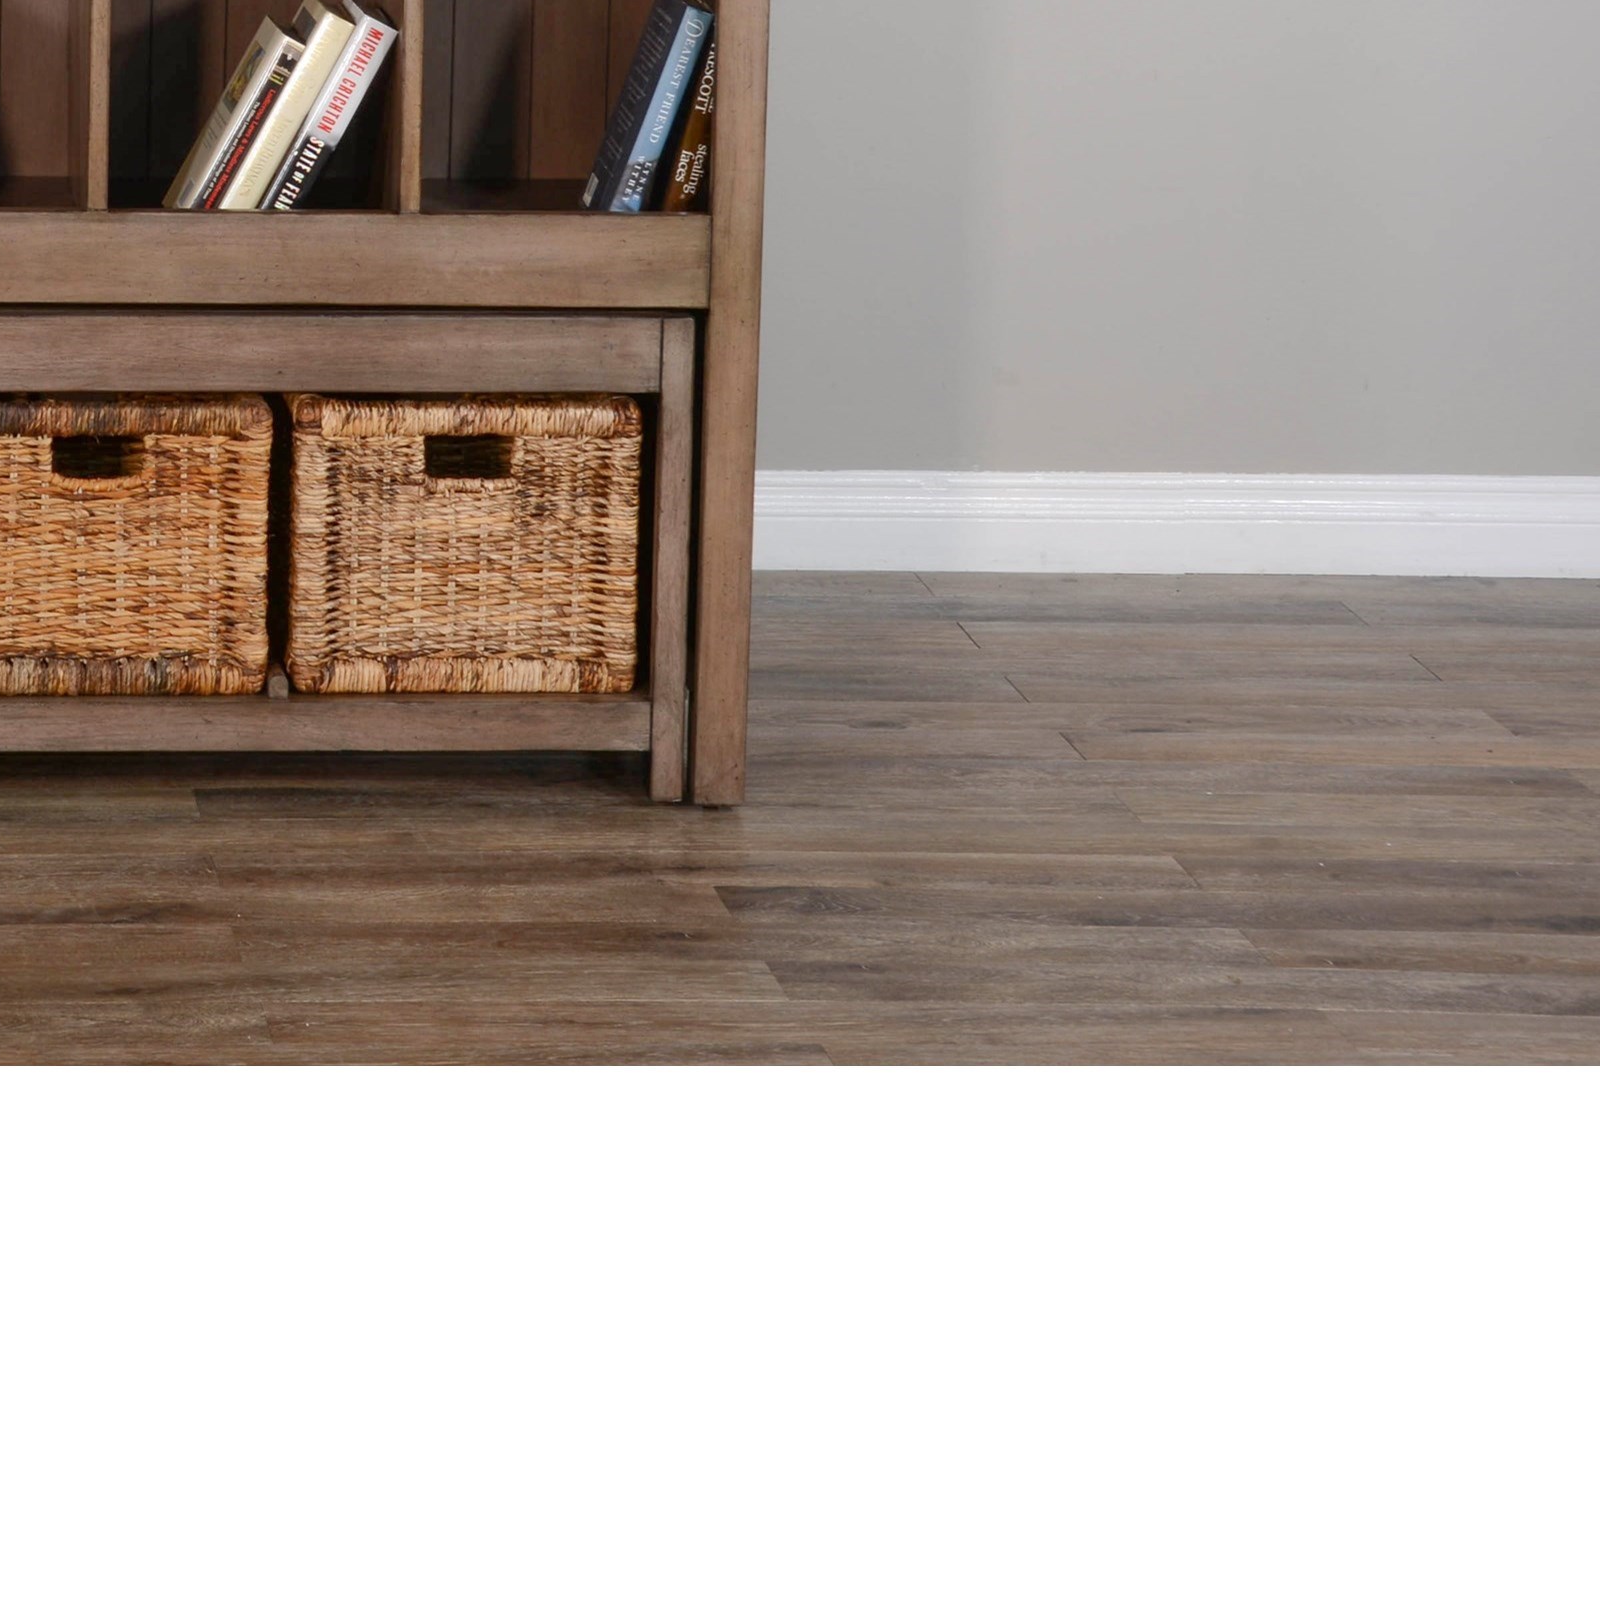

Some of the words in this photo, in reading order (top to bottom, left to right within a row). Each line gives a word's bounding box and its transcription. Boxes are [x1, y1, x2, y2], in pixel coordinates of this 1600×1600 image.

[348, 27, 384, 76] MICHAEL
[675, 21, 706, 89] DEAREST
[317, 78, 356, 133] CRICHTON
[650, 92, 675, 143] FRIEND
[296, 135, 325, 172] STATE
[621, 153, 646, 202] WITHEY
[675, 149, 695, 182] faces
[682, 144, 706, 194] stealing
[630, 161, 652, 201] LYNNE
